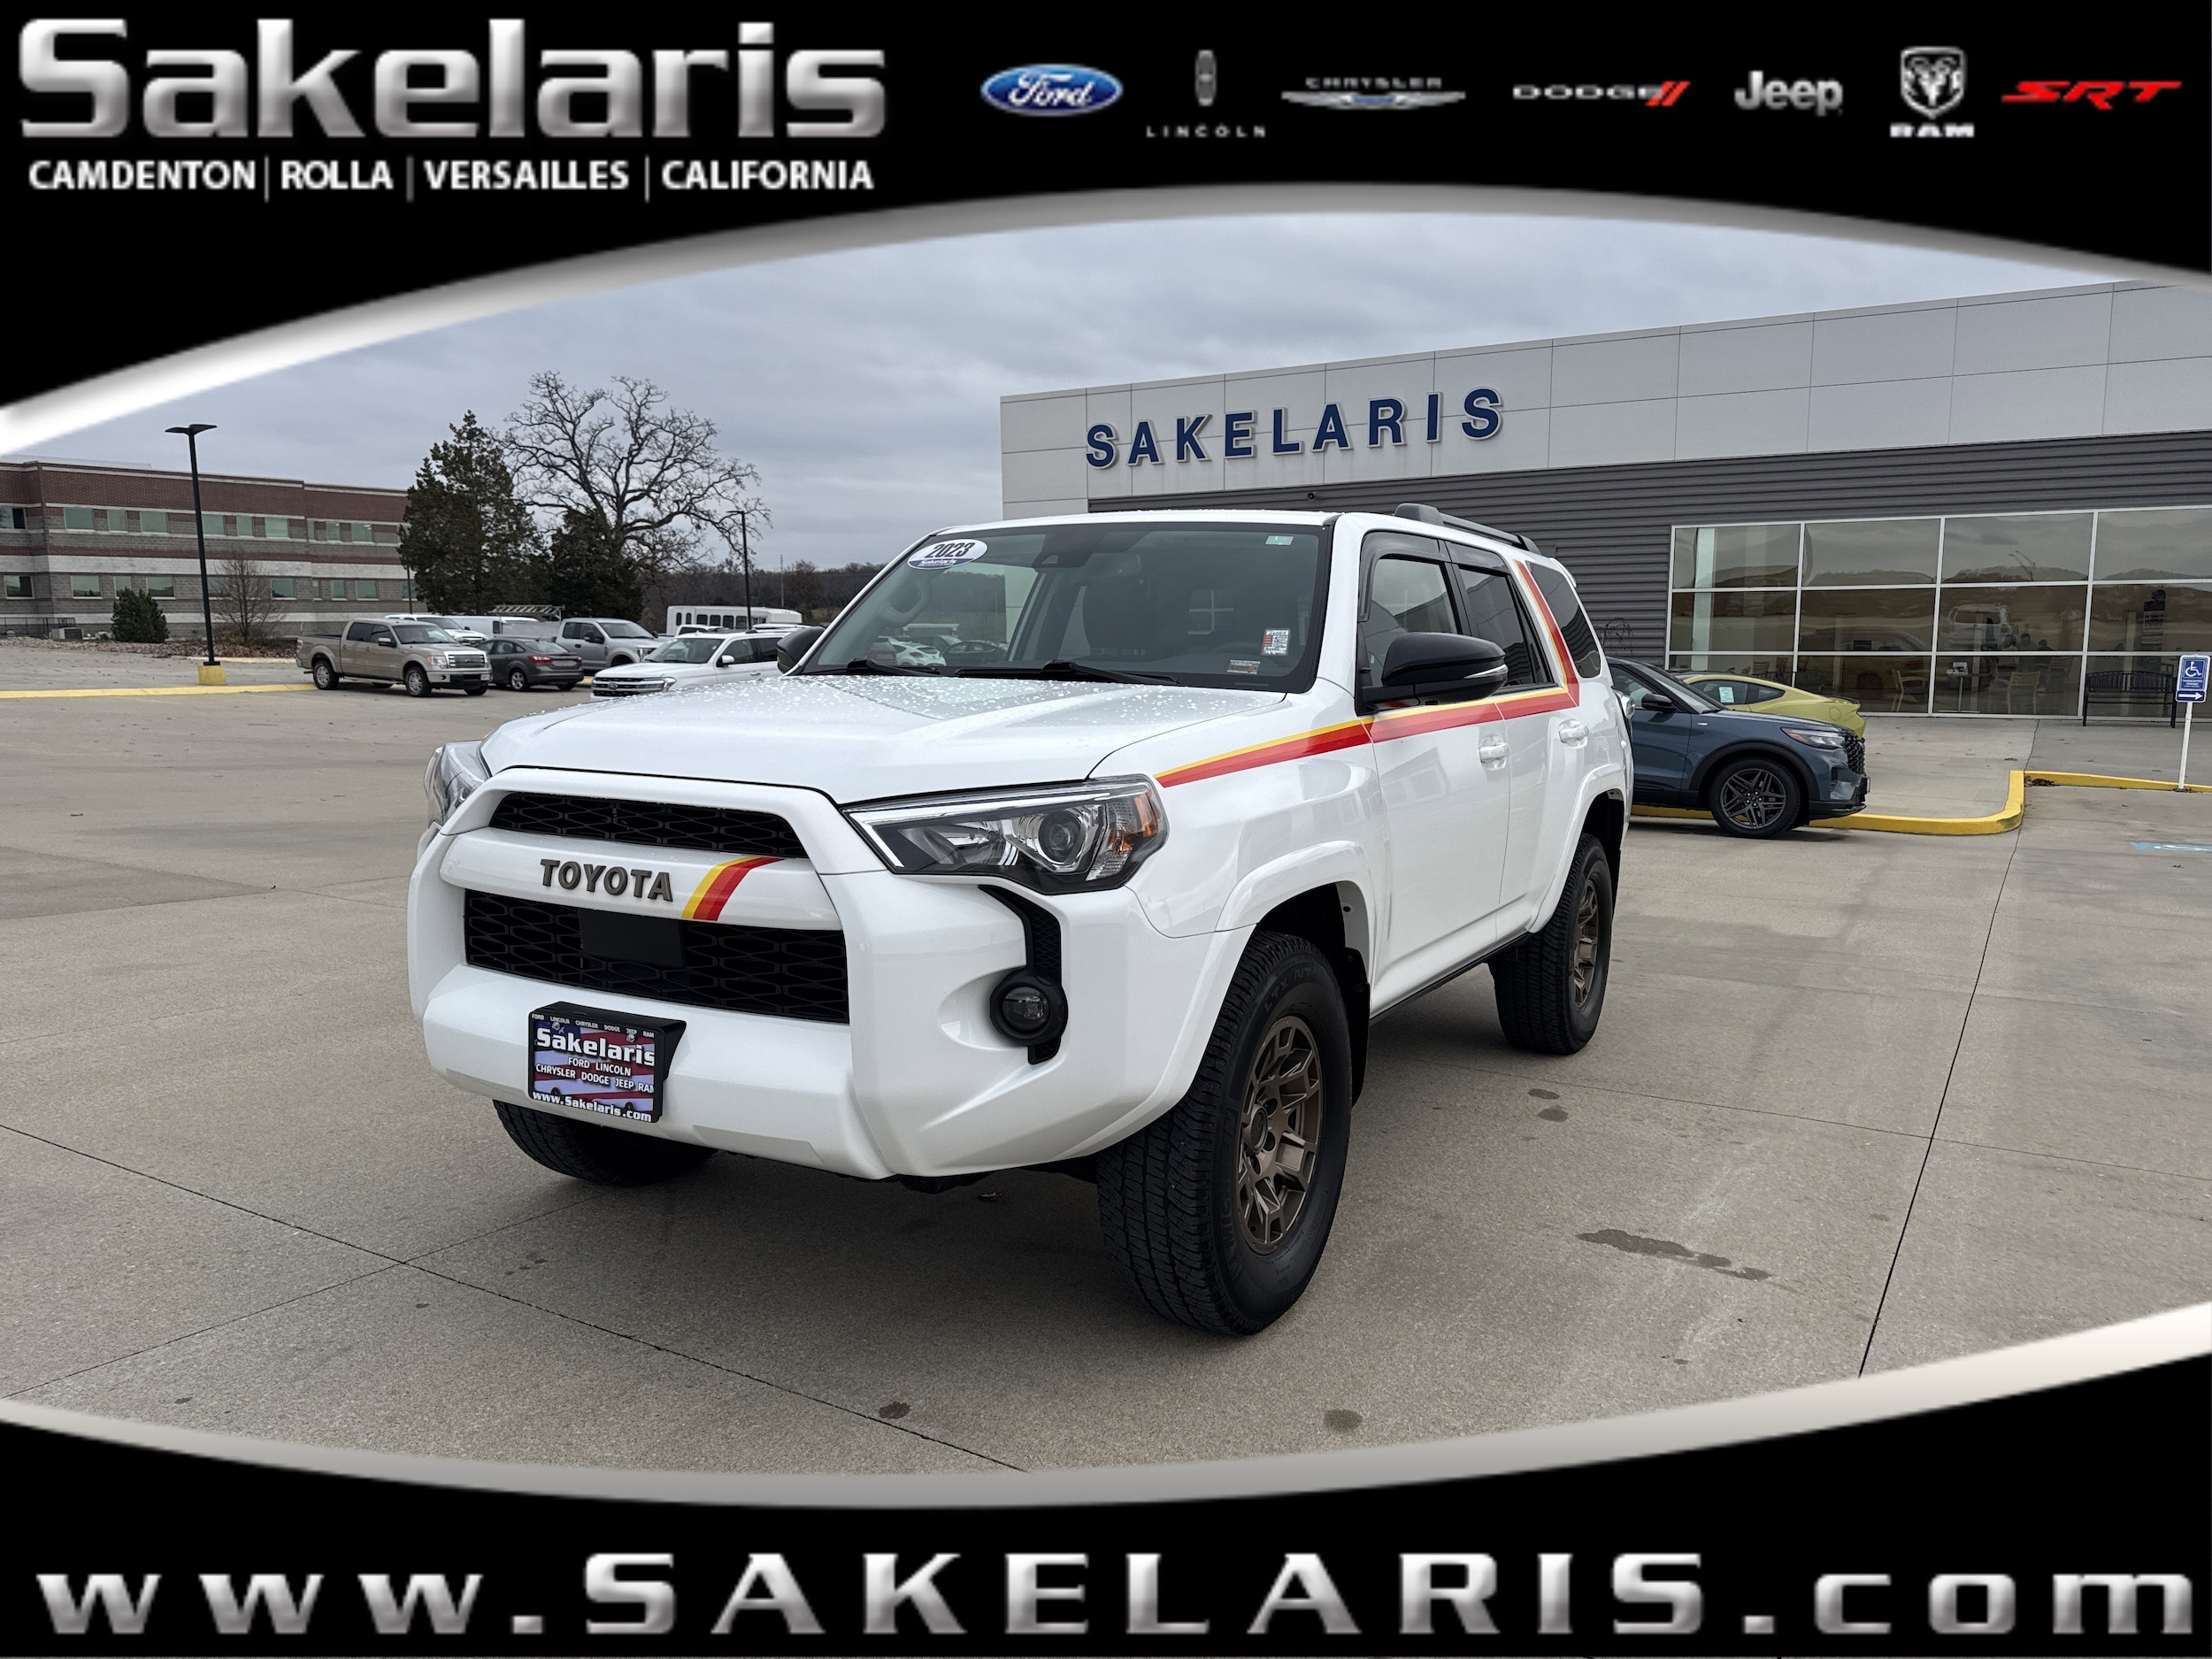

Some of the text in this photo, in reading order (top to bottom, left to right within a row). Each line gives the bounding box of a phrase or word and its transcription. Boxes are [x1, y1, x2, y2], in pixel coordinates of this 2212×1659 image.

[1085, 386, 1504, 470] SAKELARIS
[924, 541, 976, 559] 2023
[540, 858, 673, 902] TOYOTA
[549, 1016, 571, 1025] LINCOLN
[574, 1019, 599, 1029] CHRYSLER
[603, 1024, 621, 1033] DODGE
[536, 1027, 655, 1067] Sakelaris
[535, 1064, 576, 1079] CHRYSLER
[580, 1071, 610, 1086] DODGE
[614, 1078, 634, 1090] JEEP
[568, 1056, 632, 1077] FORD LINCOLN
